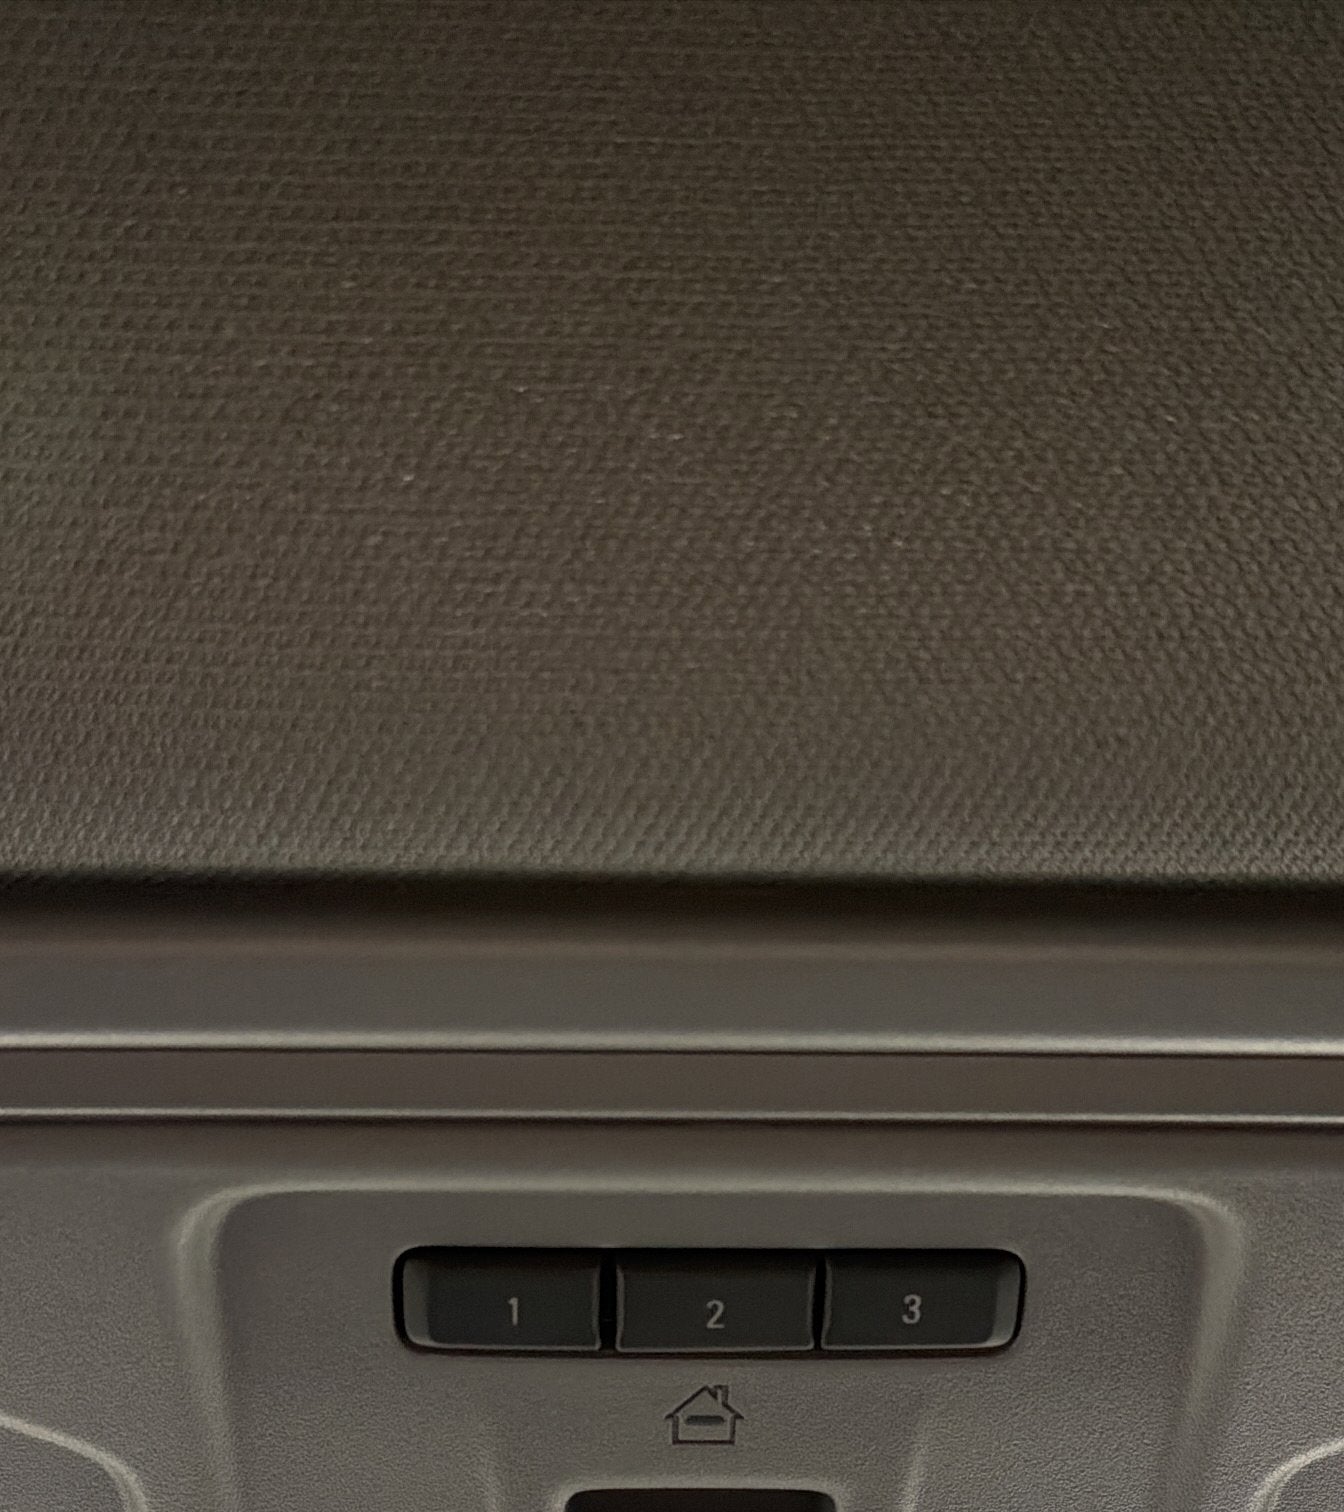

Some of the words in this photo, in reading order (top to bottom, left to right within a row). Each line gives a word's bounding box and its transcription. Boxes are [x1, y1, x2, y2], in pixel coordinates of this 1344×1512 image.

[507, 1296, 520, 1326] 1
[706, 1299, 725, 1330] 2
[902, 1294, 922, 1324] 3
